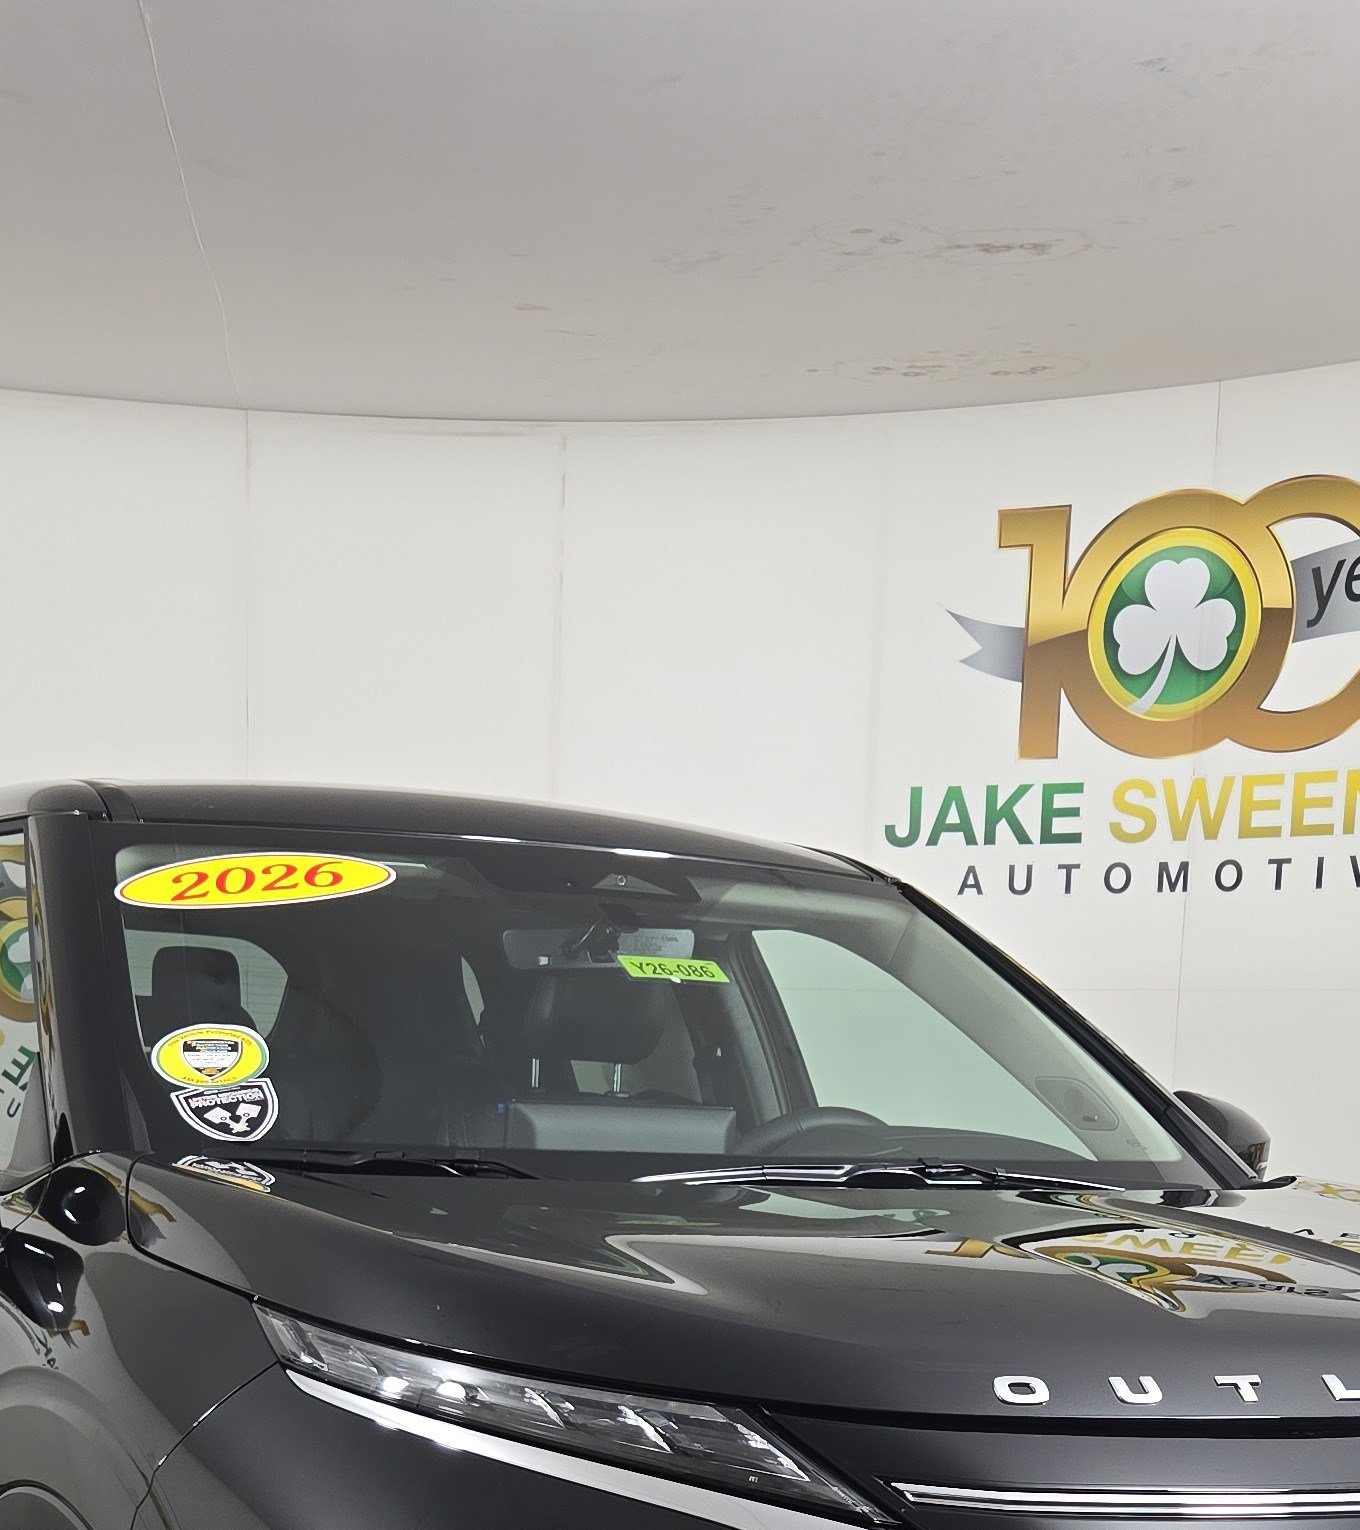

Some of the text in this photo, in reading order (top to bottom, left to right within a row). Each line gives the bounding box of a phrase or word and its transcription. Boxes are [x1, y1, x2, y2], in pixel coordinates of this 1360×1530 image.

[884, 781, 1085, 848] JAKE
[170, 861, 344, 901] 2026
[630, 961, 715, 979] Y26-086
